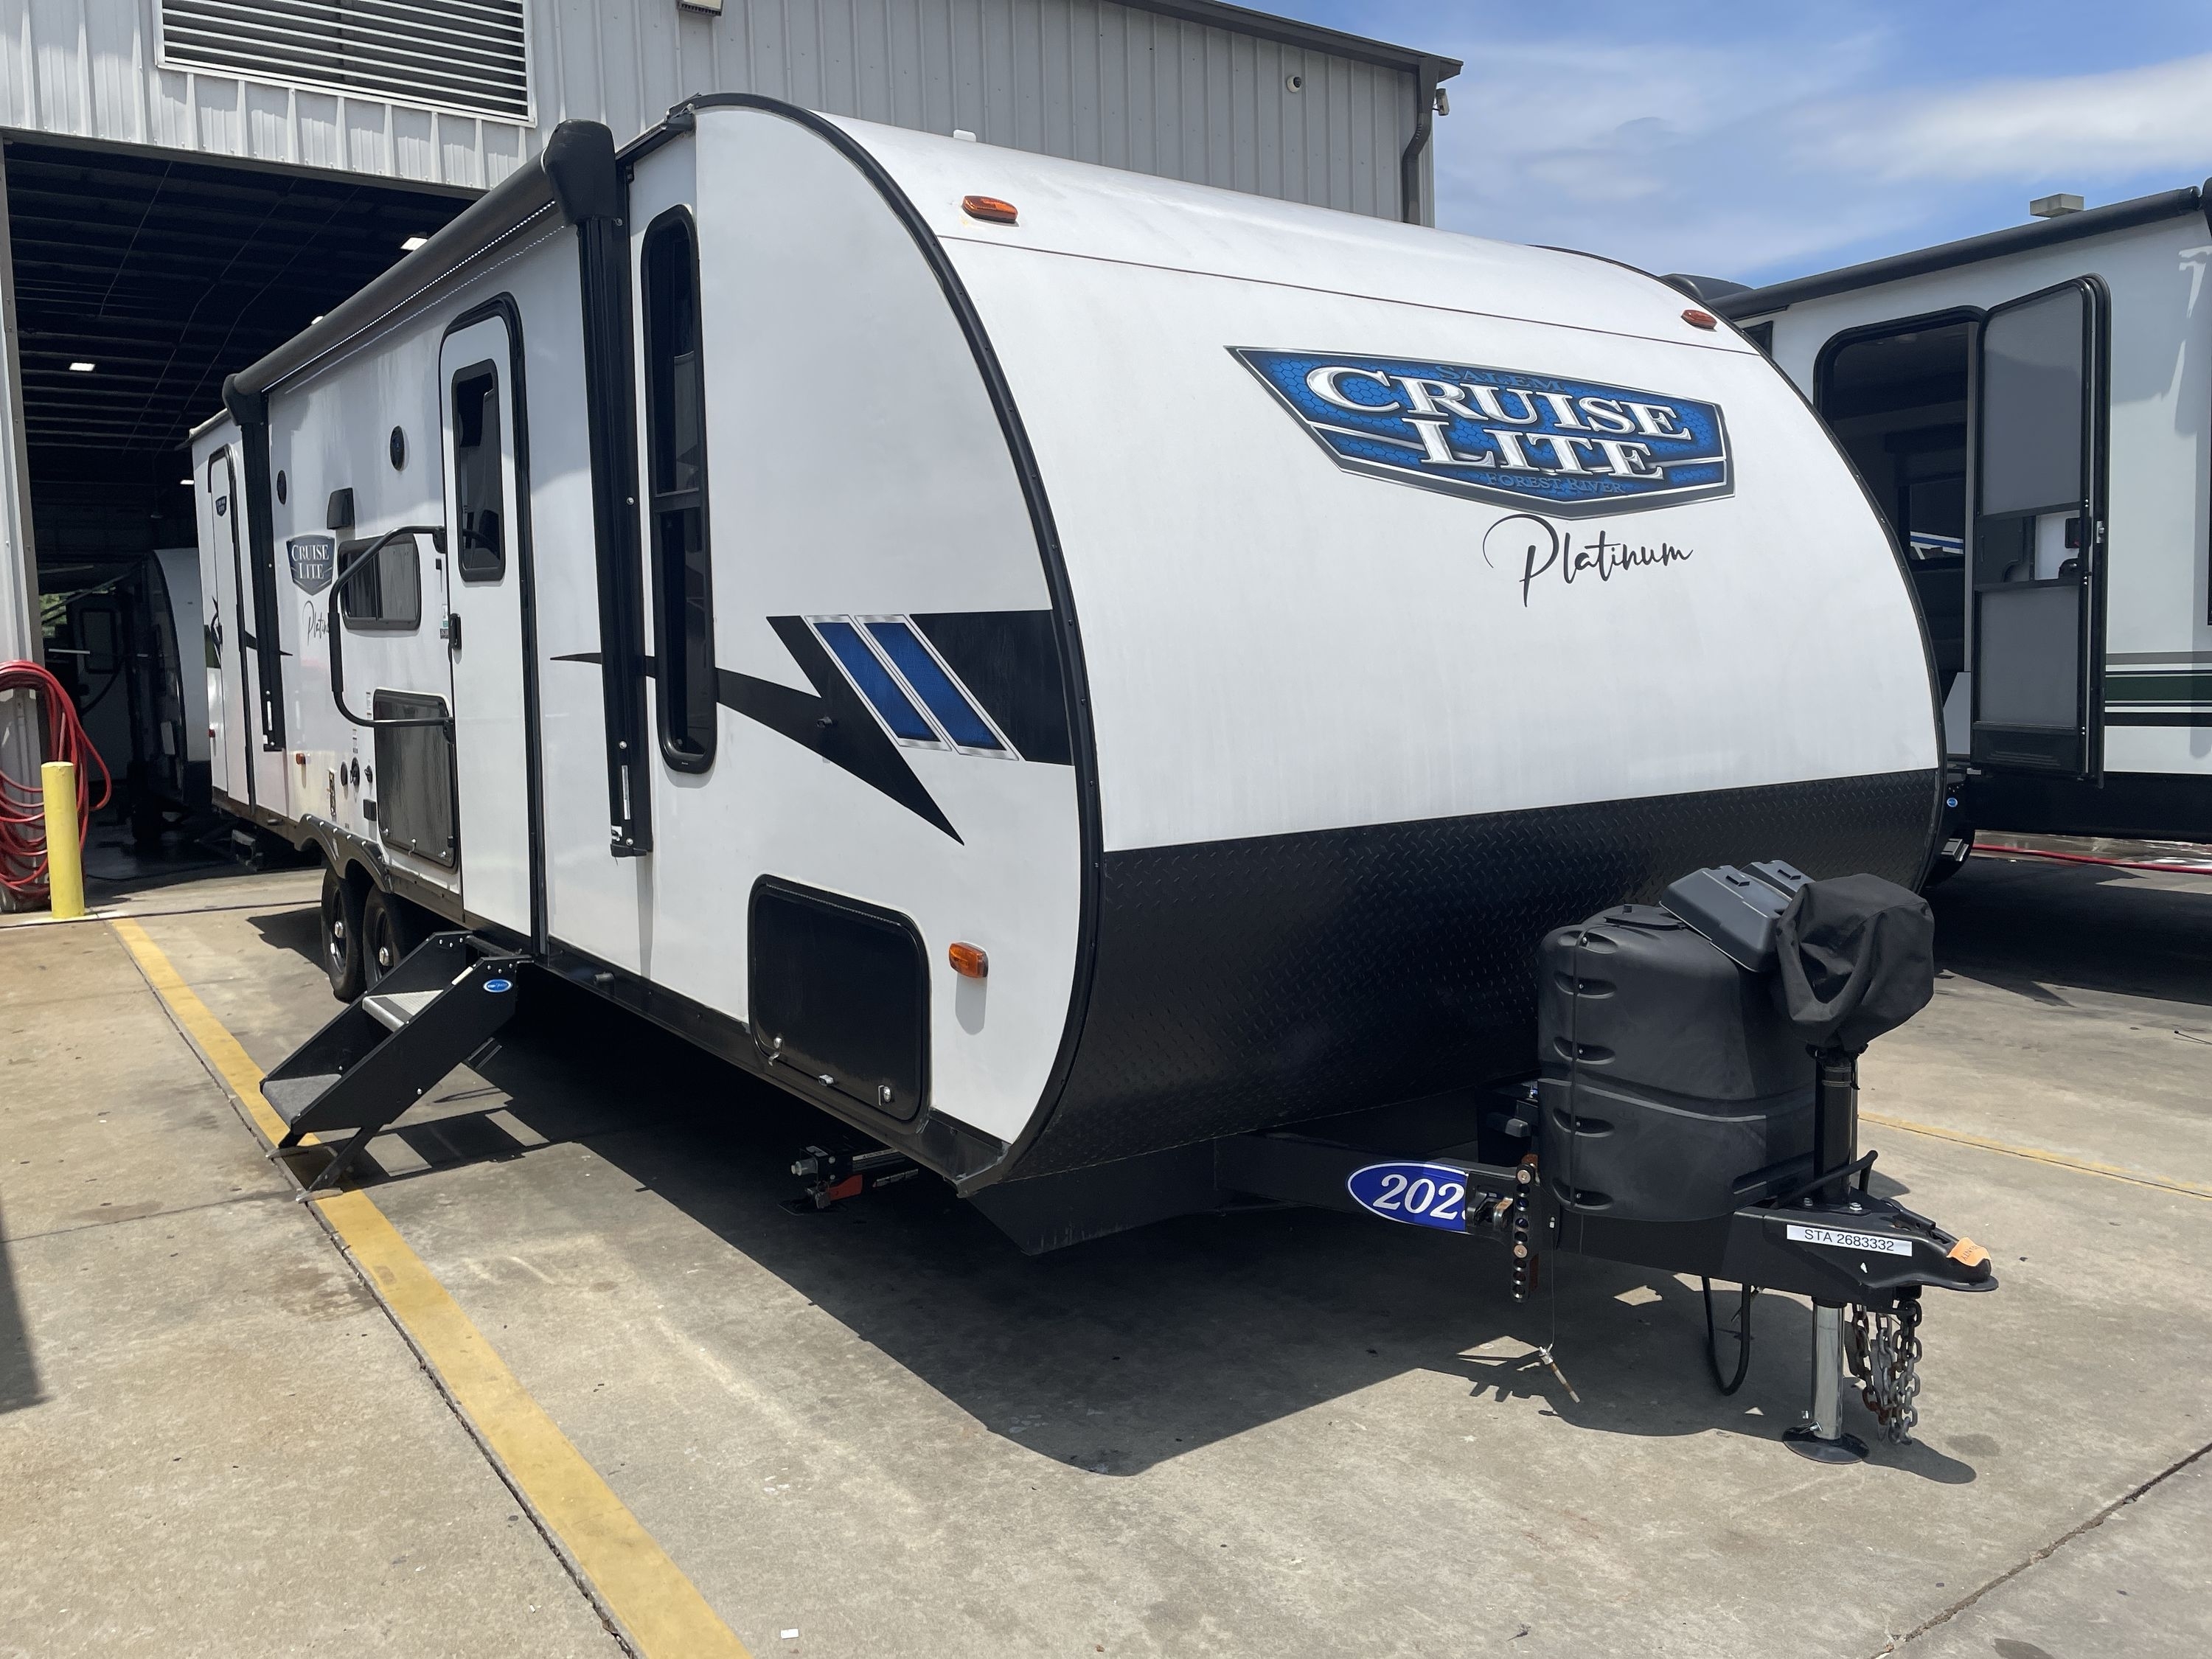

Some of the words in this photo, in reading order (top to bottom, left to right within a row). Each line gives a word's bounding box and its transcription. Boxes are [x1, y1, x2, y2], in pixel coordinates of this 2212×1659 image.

[1436, 365, 1565, 392] SALEM
[1306, 366, 1692, 440] CRUISE
[1401, 417, 1665, 479] LITE
[1486, 472, 1562, 490] FOREST
[1568, 478, 1626, 494] RIVER
[291, 544, 330, 562] CRUISE
[1482, 513, 1694, 608] Platinum
[299, 563, 324, 580] LITE
[1373, 1174, 1466, 1220] 202
[1804, 1229, 1833, 1243] STA
[1837, 1234, 1895, 1252] 2683332
